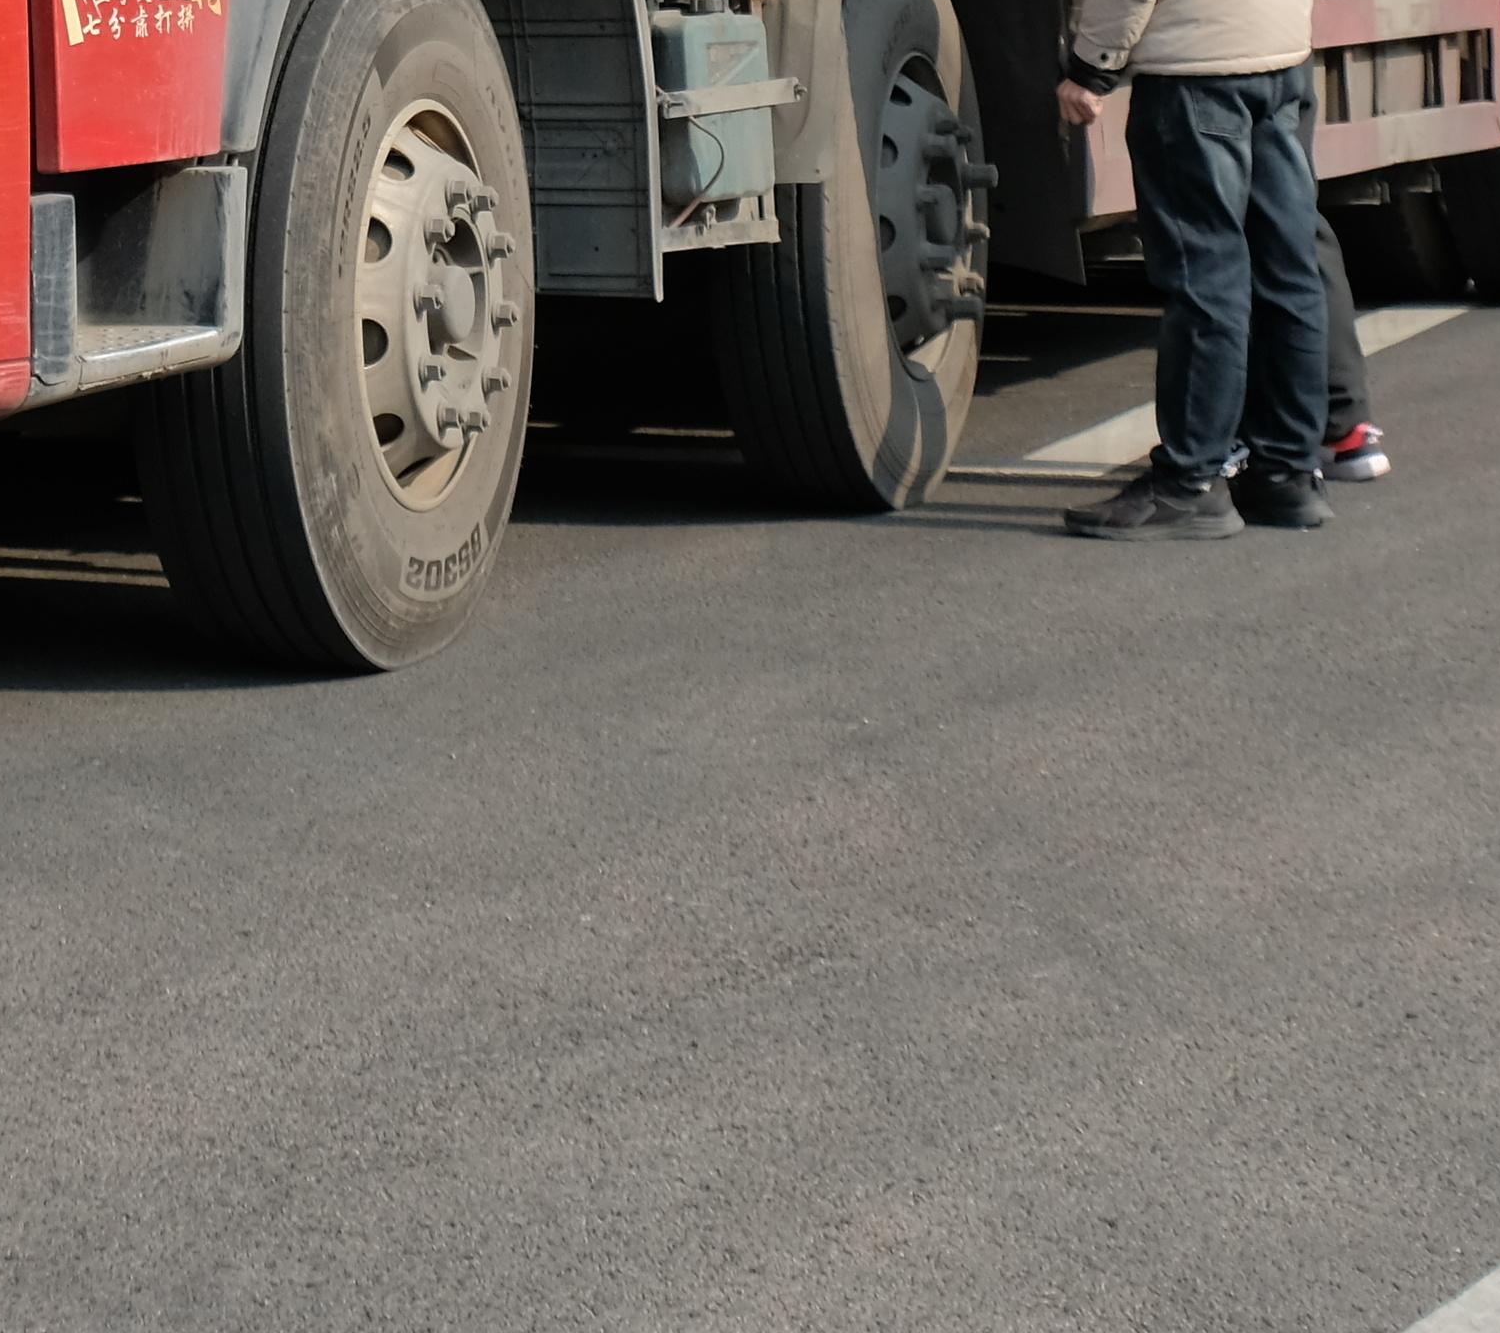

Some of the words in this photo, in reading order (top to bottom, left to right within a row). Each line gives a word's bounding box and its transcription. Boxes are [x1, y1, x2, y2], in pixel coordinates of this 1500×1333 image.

[82, 4, 195, 40] 七分靠打拼
